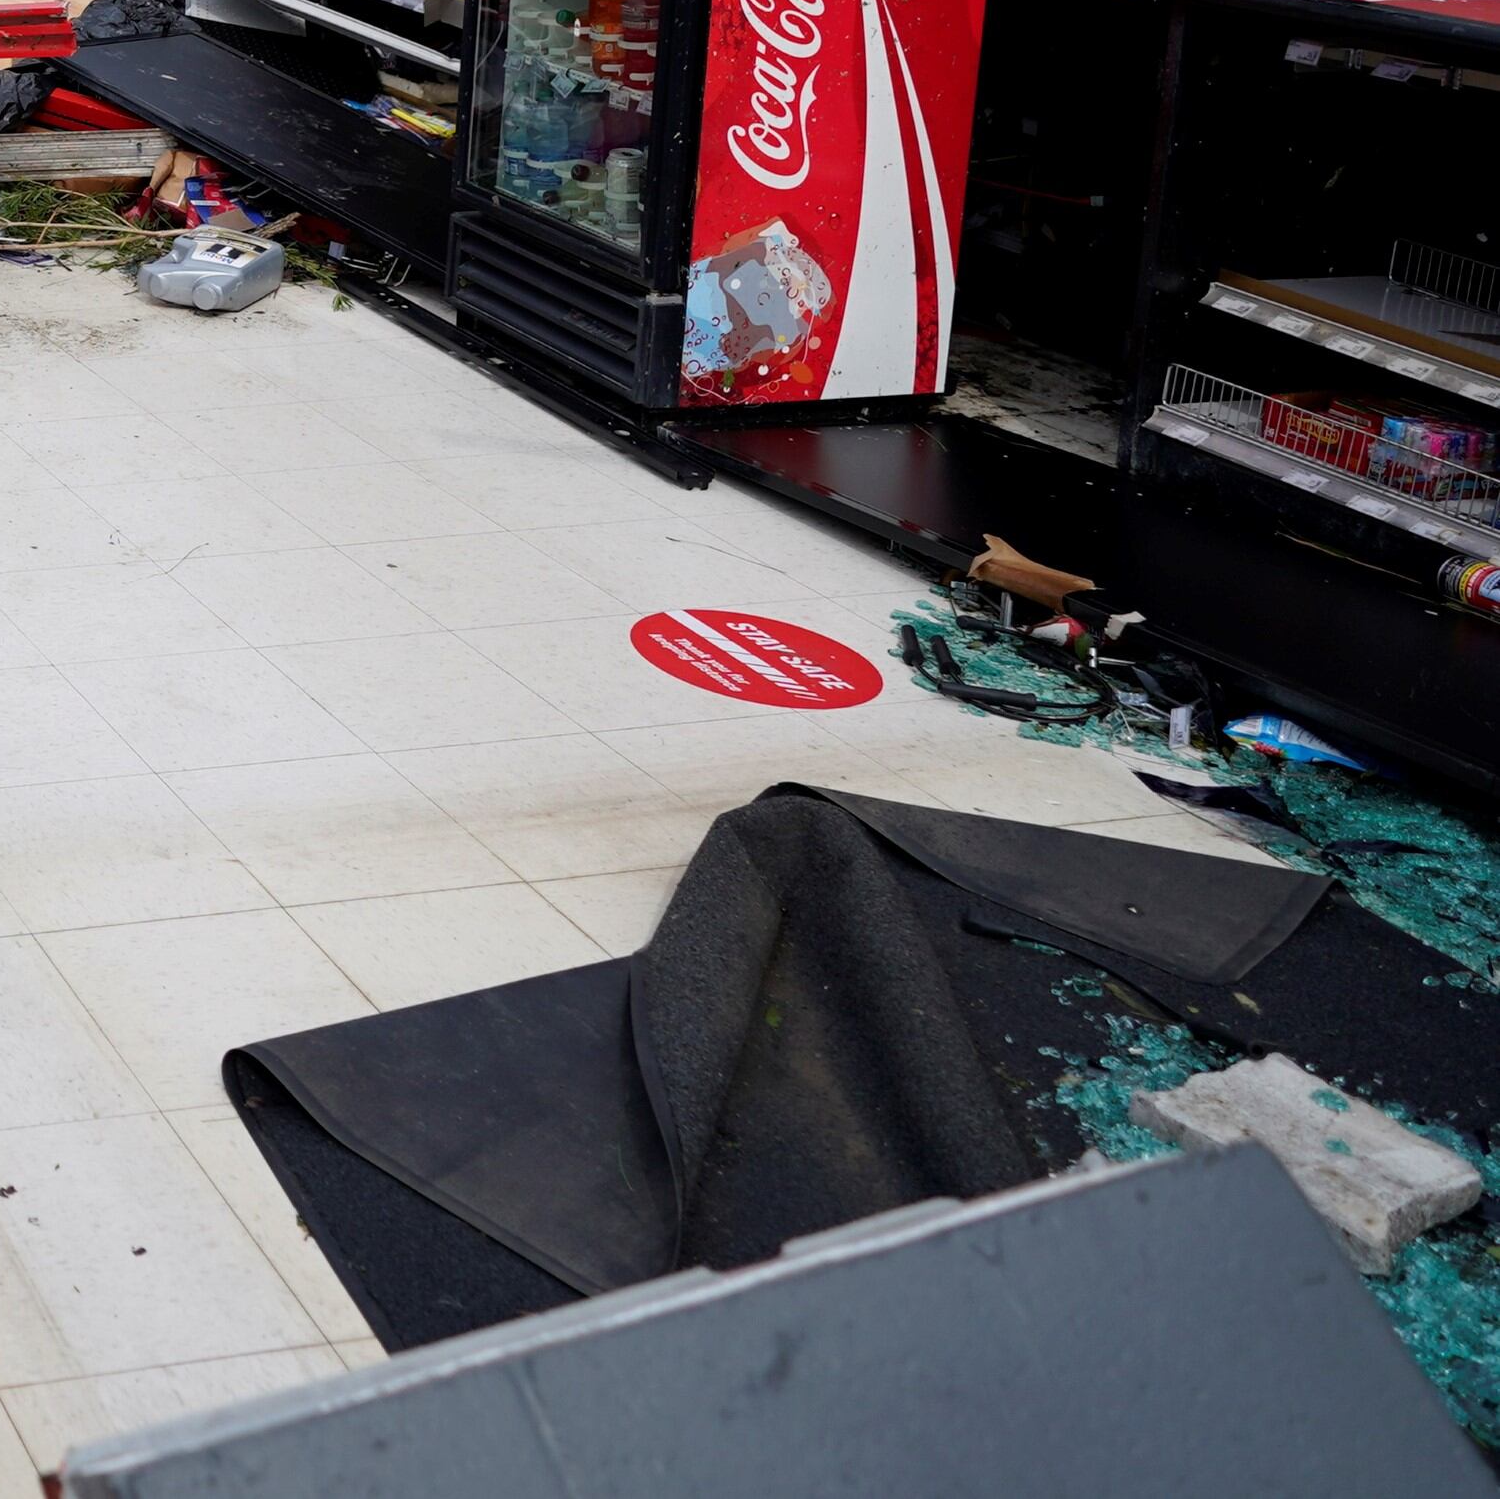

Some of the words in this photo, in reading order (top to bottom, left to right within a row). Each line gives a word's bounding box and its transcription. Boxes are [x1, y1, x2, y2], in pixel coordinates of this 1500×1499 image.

[675, 638, 711, 661] Thank
[705, 656, 731, 673] you
[726, 622, 796, 654] STAY
[780, 655, 855, 691] SAFE
[691, 661, 742, 692] distance
